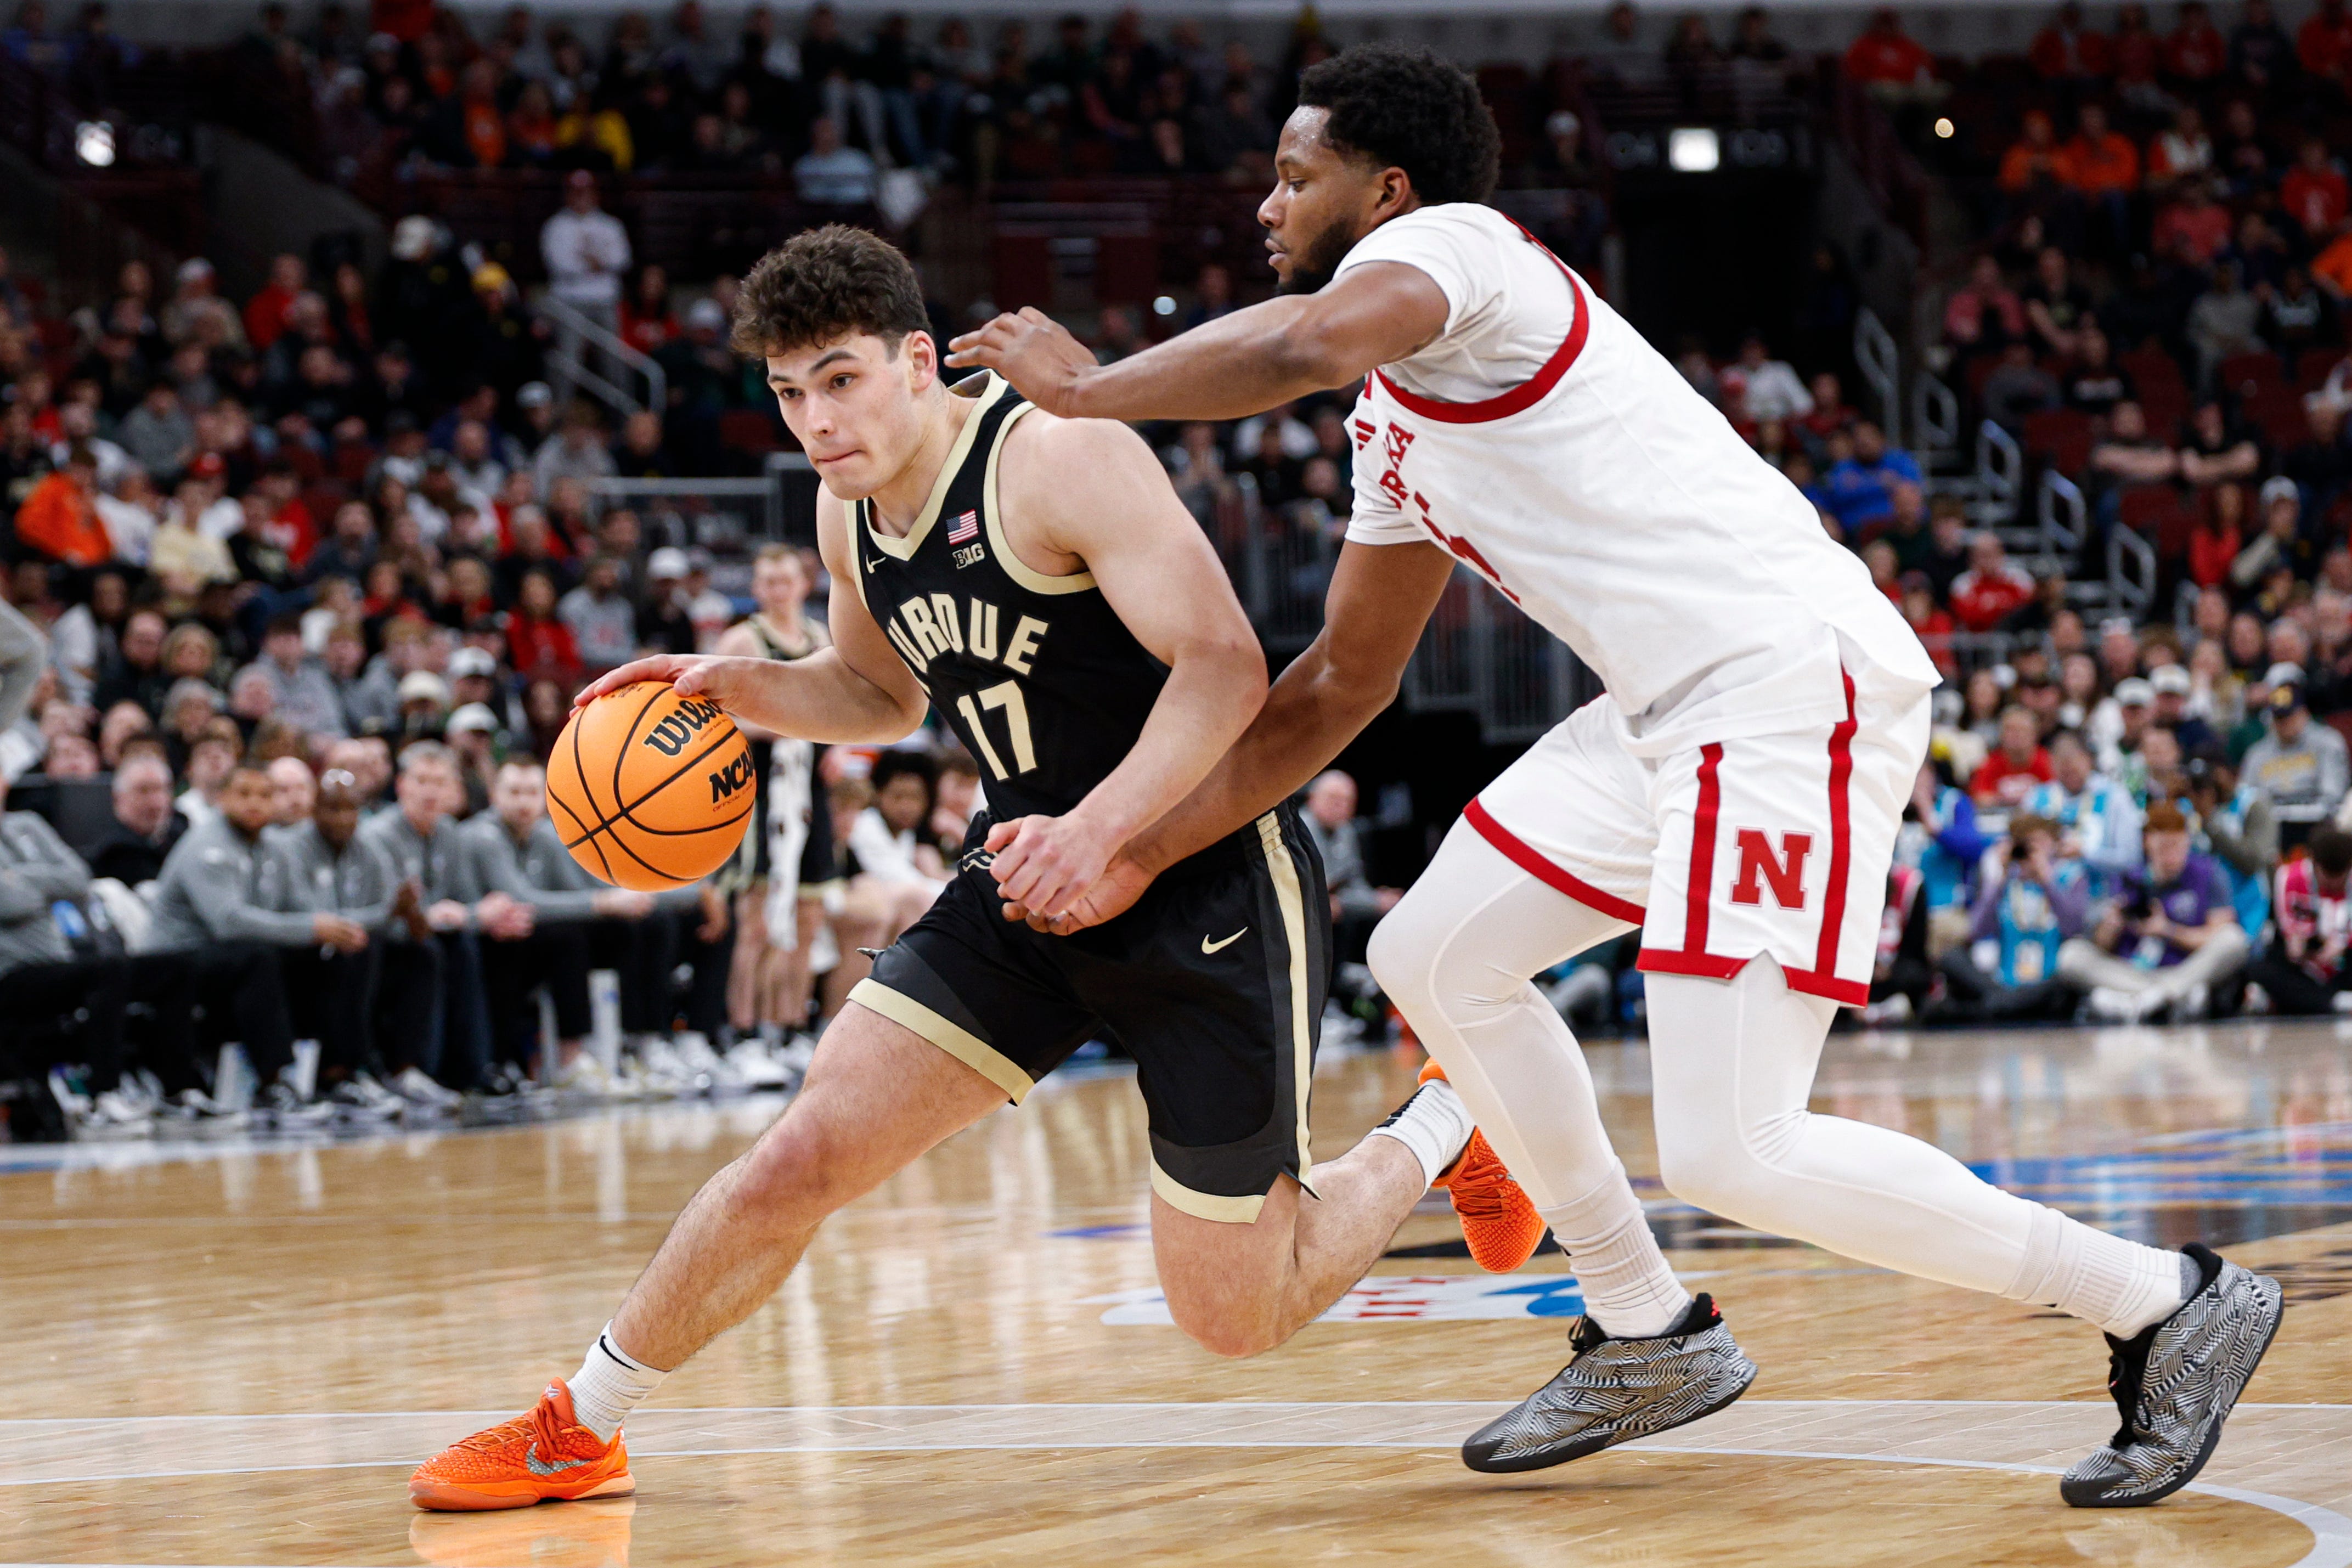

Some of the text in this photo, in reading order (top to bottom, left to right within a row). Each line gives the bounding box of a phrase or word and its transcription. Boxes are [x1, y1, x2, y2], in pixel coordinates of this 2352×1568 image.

[888, 591, 1050, 676] URDUE
[642, 700, 723, 757] Wilso
[956, 679, 1037, 781] 17
[709, 744, 754, 804] NCA
[1728, 825, 1815, 912] N
